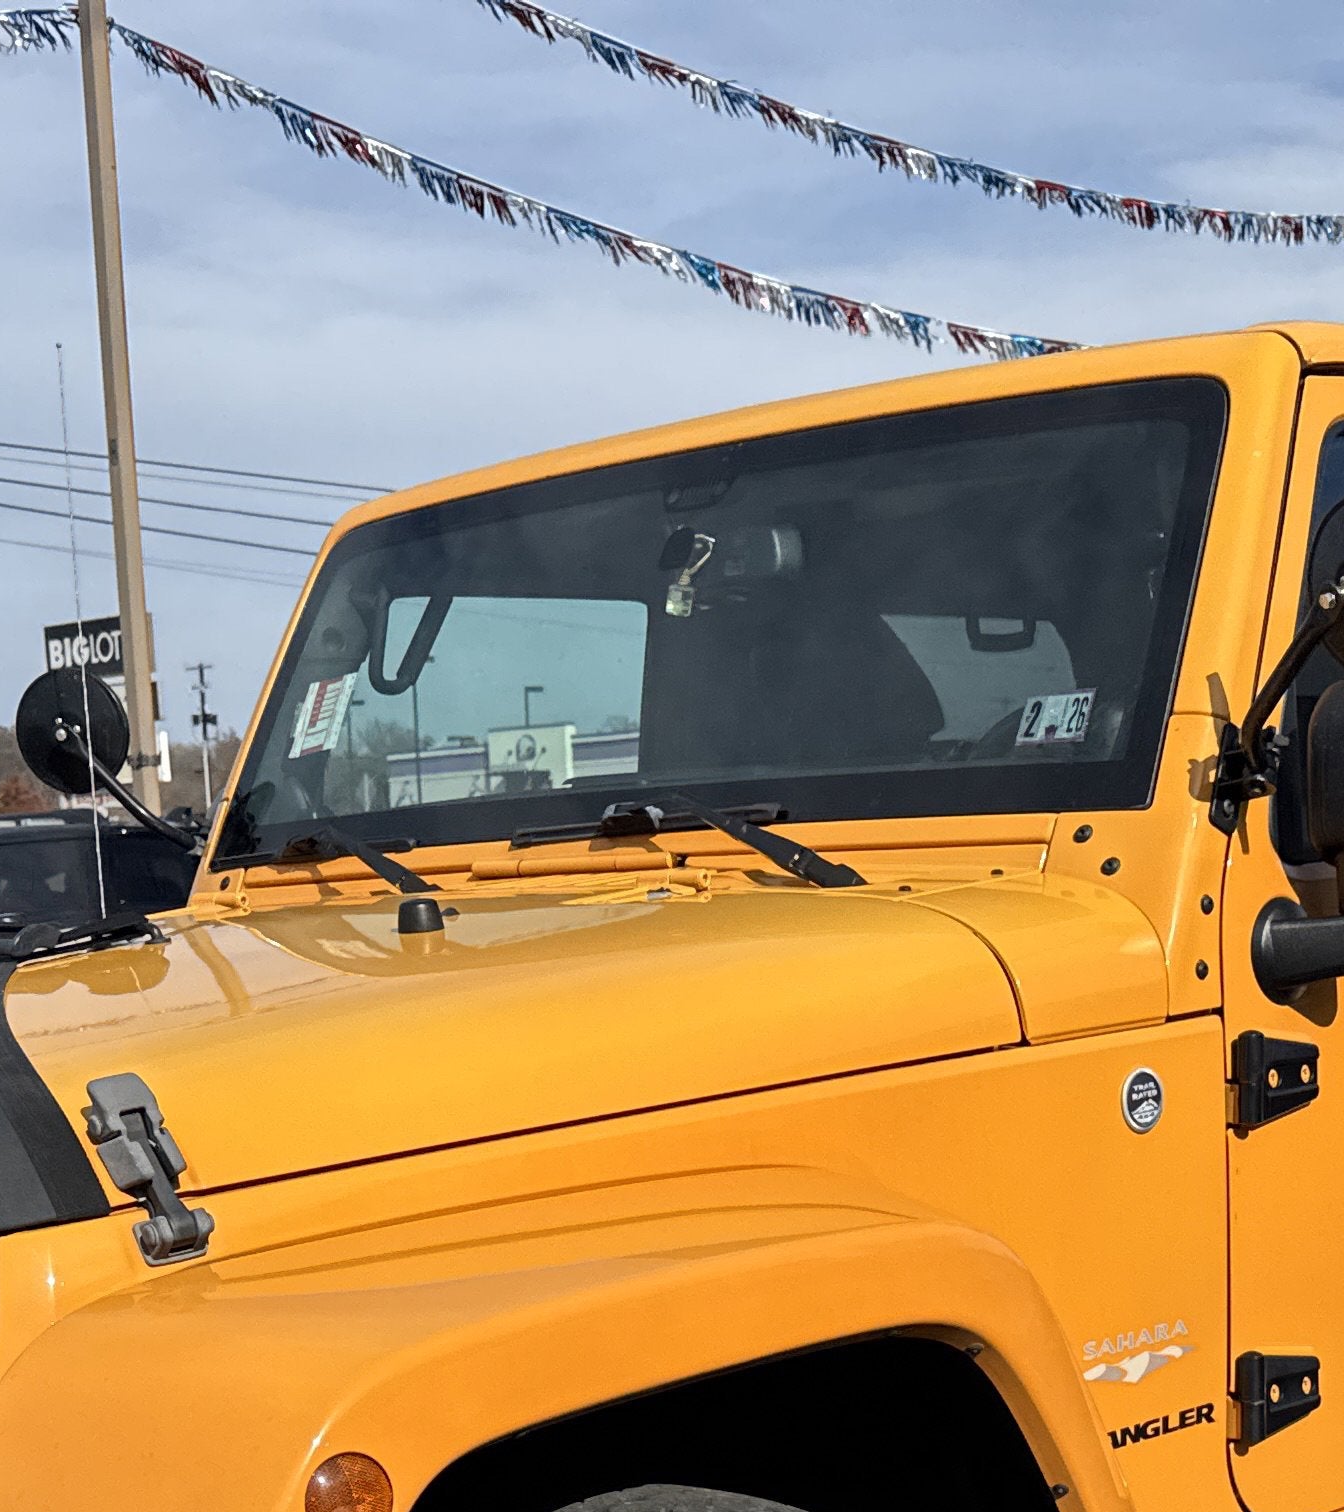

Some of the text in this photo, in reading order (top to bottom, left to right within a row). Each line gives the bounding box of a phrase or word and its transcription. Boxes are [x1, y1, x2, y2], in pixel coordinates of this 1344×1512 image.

[1066, 696, 1089, 733] 26
[1131, 1089, 1158, 1101] RATED
[1083, 1319, 1189, 1361] SAHARA
